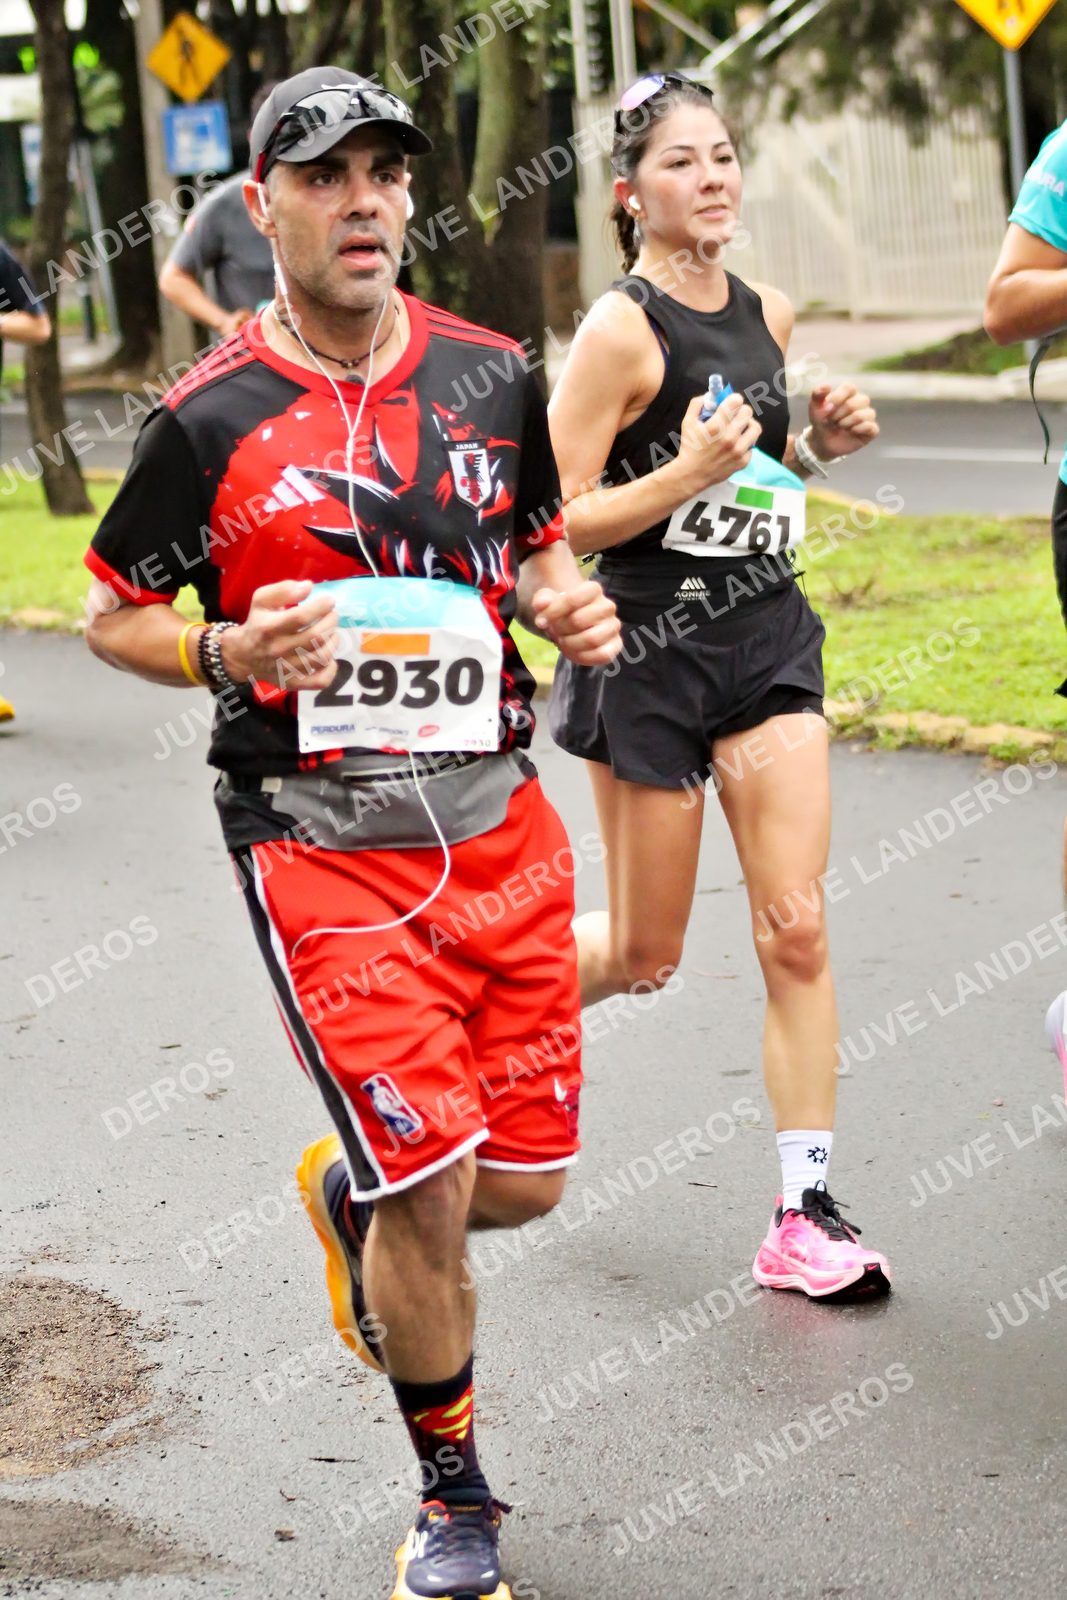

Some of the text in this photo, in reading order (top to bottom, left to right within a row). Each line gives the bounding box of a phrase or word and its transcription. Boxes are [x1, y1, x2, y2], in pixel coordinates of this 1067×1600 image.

[455, 442, 478, 450] JAPAN
[681, 500, 791, 554] 4761
[314, 657, 484, 709] 2930
